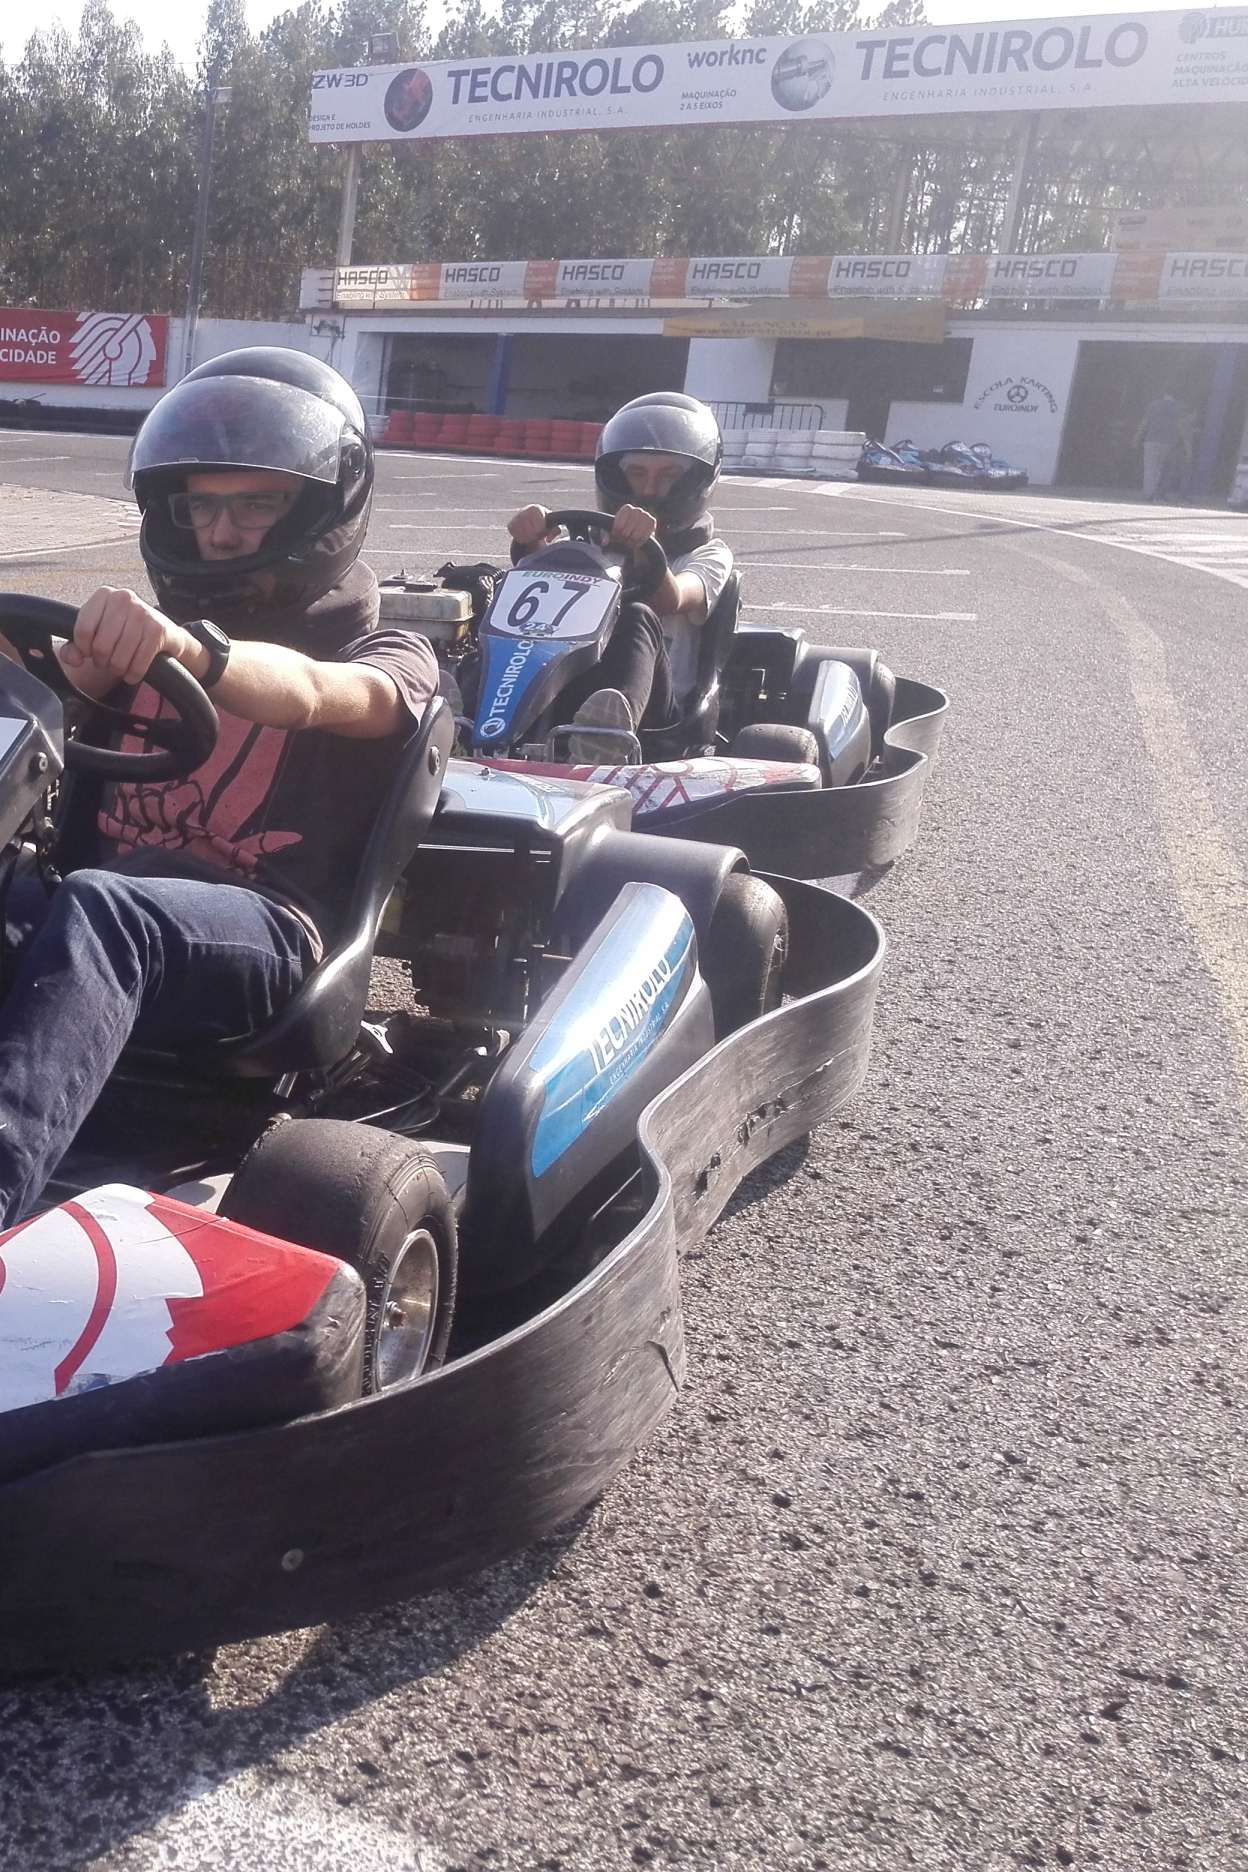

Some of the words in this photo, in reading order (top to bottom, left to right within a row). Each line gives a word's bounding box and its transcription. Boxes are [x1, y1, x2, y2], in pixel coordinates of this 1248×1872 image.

[856, 22, 1149, 81] TECNIROLO
[447, 54, 665, 105] TECNIROLO
[1171, 79, 1199, 88] ALTA
[681, 89, 737, 100] MAQUINAÇÃO
[883, 87, 967, 101] ENGENHARIA
[699, 101, 723, 109] EIXOS
[468, 111, 532, 123] ENGENHARIA
[444, 267, 501, 283] HASCO
[561, 265, 625, 281] HASCO
[692, 262, 762, 280] HASCO
[835, 261, 912, 279] HASCO
[993, 259, 1078, 278] HASCO
[1170, 258, 1248, 278] HASC
[337, 270, 389, 286] HASCO
[522, 571, 603, 585] EUROINDY
[507, 581, 591, 627] 67
[489, 640, 535, 717] TECNIROLO
